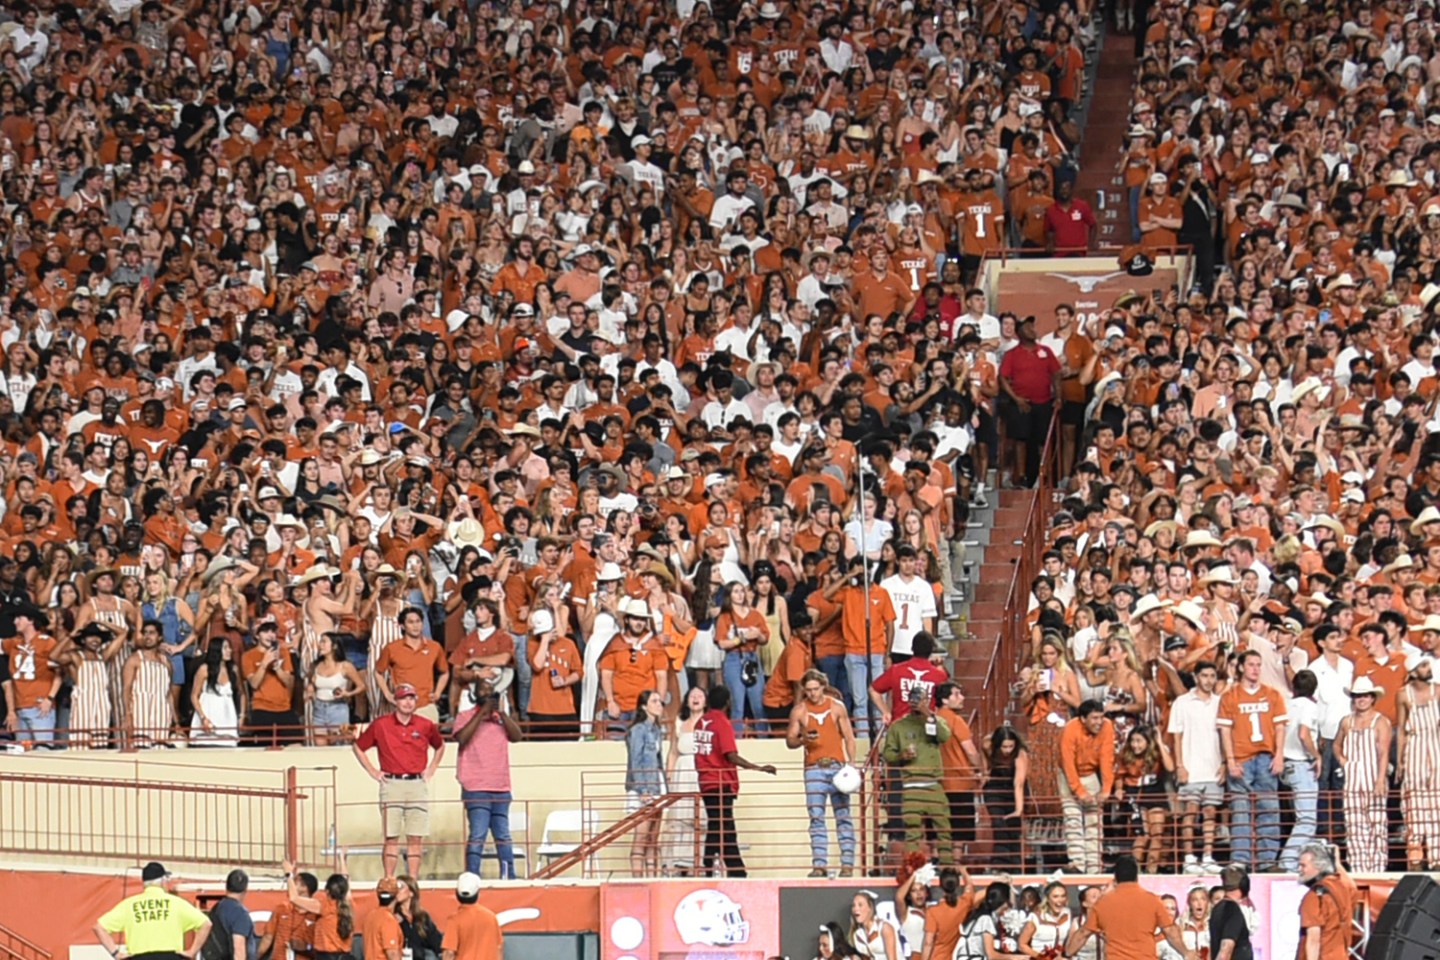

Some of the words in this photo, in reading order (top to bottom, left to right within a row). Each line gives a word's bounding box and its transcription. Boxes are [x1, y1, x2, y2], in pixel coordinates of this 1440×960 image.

[976, 214, 986, 237] 1
[910, 267, 921, 291] 1
[893, 592, 920, 604] TEXAS
[898, 602, 910, 630] 1
[900, 678, 936, 696] EVENT
[1237, 702, 1270, 714] TEXAS
[1248, 712, 1265, 743] 1
[133, 899, 170, 913] EVENT
[134, 910, 170, 924] STAFF
